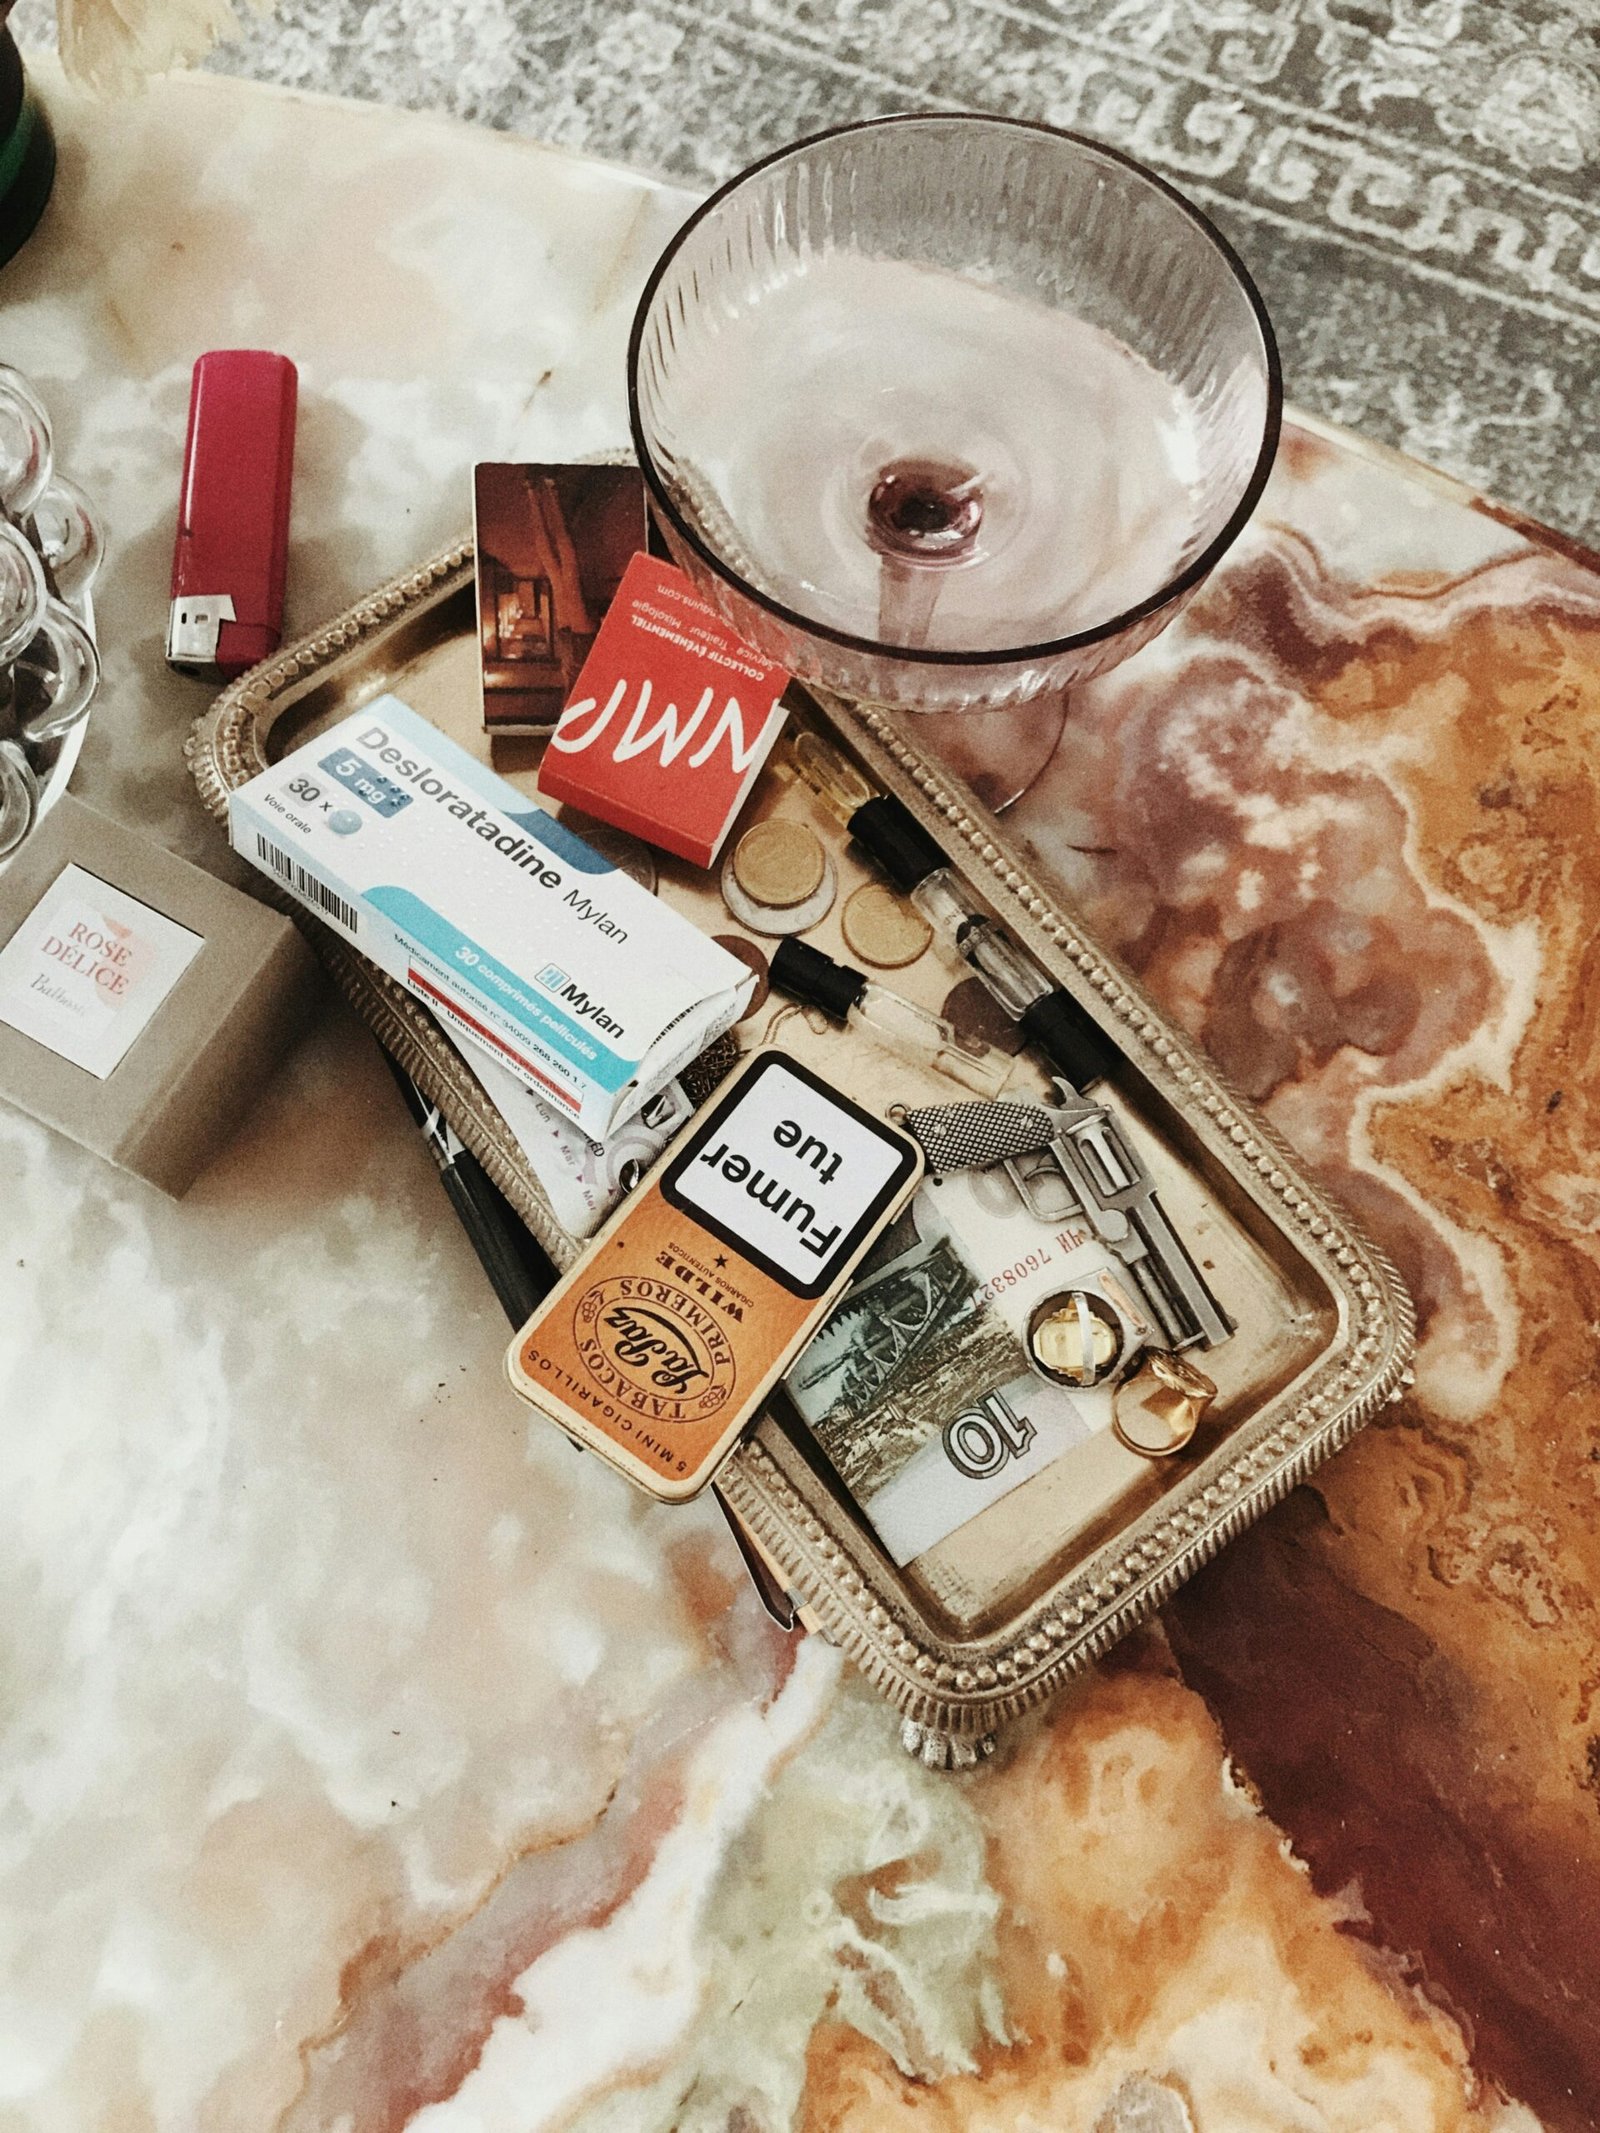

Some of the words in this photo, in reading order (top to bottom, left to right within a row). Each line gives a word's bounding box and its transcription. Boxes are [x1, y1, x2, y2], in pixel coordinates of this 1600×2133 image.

[631, 600, 682, 629] Mixologie
[631, 614, 708, 658] ÉVÉNEMENTIEL
[689, 626, 728, 650] Traiteur
[707, 651, 765, 682] COLLECTIF
[289, 778, 320, 802] 30
[335, 759, 362, 777] 5
[354, 778, 387, 804] mg
[264, 794, 286, 813] Voie
[286, 813, 312, 834] orale
[356, 727, 563, 890] Desloratadine
[563, 889, 629, 945] Mylan
[41, 936, 129, 996] DÉLICE
[69, 922, 133, 968] ROSE
[394, 933, 450, 980] Médicament
[533, 1043, 551, 1061] 268
[552, 1060, 571, 1077] 260
[455, 946, 480, 966] 30
[478, 964, 542, 1017] comprimés
[540, 1014, 598, 1061] pelliculés
[560, 983, 625, 1039] Mylan
[407, 978, 430, 1000] Liste
[447, 1010, 504, 1059] Uniquement
[506, 1058, 521, 1072] sur
[523, 1072, 580, 1119] ordonnance
[535, 1102, 551, 1123] Lun
[560, 1145, 575, 1166] Mar
[582, 1189, 597, 1211] Mer
[773, 1119, 843, 1186] tue
[699, 1143, 843, 1259] Fumer
[655, 1250, 745, 1323] WILDE
[667, 1242, 715, 1279] AUTENTICOS
[715, 1277, 755, 1308] CIGARROS
[603, 1307, 668, 1367] Paz
[620, 1279, 731, 1366] PRIMEROS
[528, 1350, 632, 1431] CIGARILLOS
[579, 1338, 686, 1419] TABACOS
[651, 1348, 710, 1394] La
[635, 1430, 674, 1463] MINI
[942, 1388, 1038, 1480] 10
[676, 1460, 687, 1472] 5
